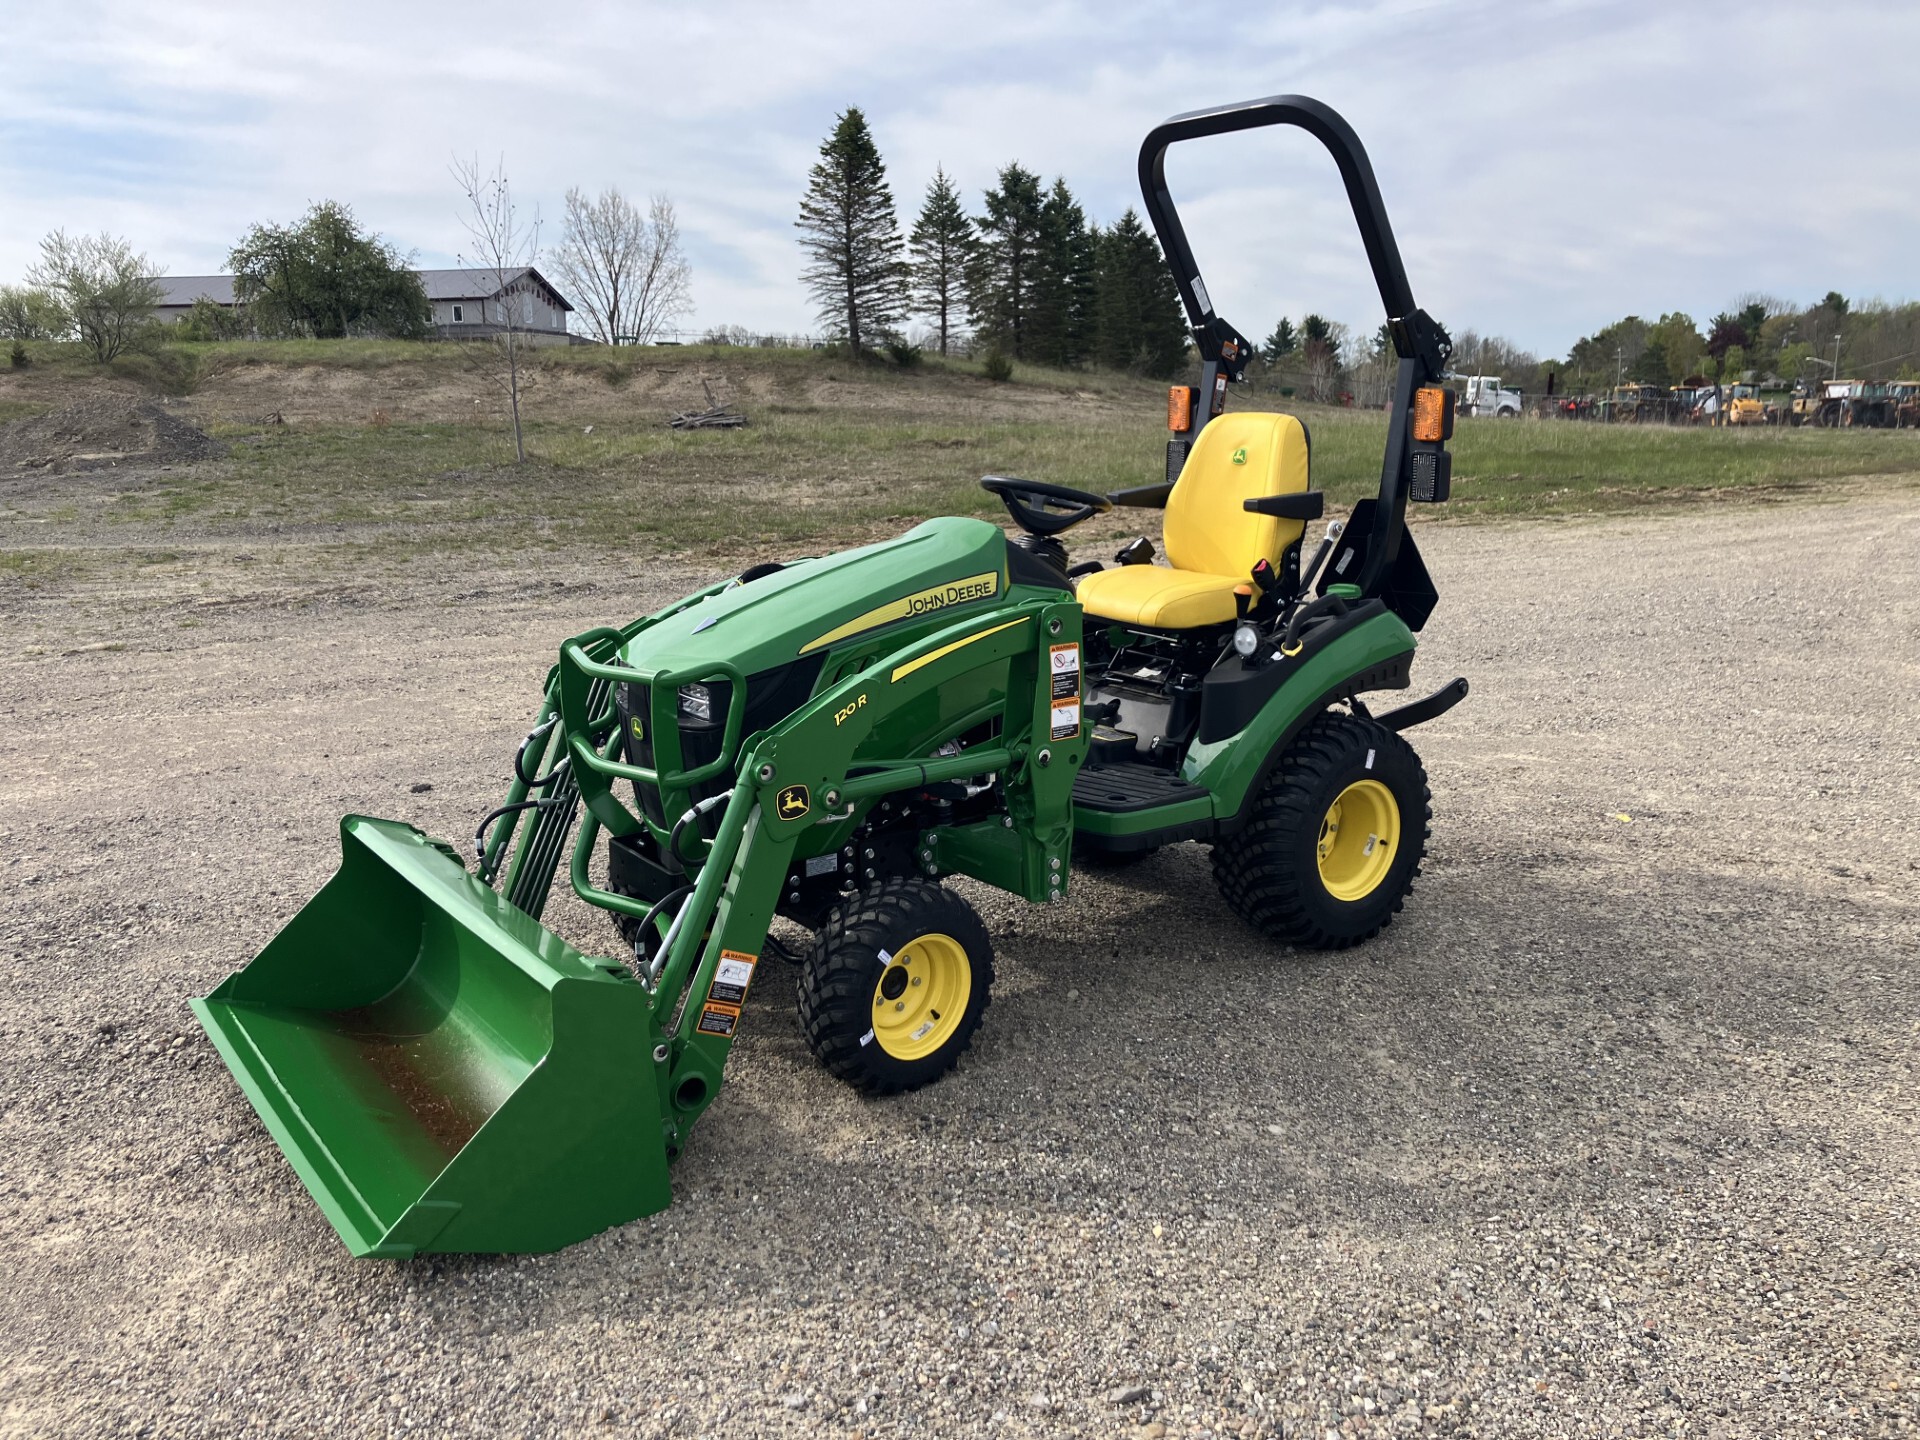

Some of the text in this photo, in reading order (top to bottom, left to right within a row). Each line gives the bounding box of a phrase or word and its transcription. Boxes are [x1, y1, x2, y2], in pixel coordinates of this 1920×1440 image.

[905, 581, 992, 616] JOHN DEERE
[1055, 643, 1078, 652] WARNING
[1056, 700, 1079, 708] WARNING
[833, 693, 868, 727] 120 R
[730, 953, 753, 962] WARNING
[713, 1006, 736, 1014] WARNING
